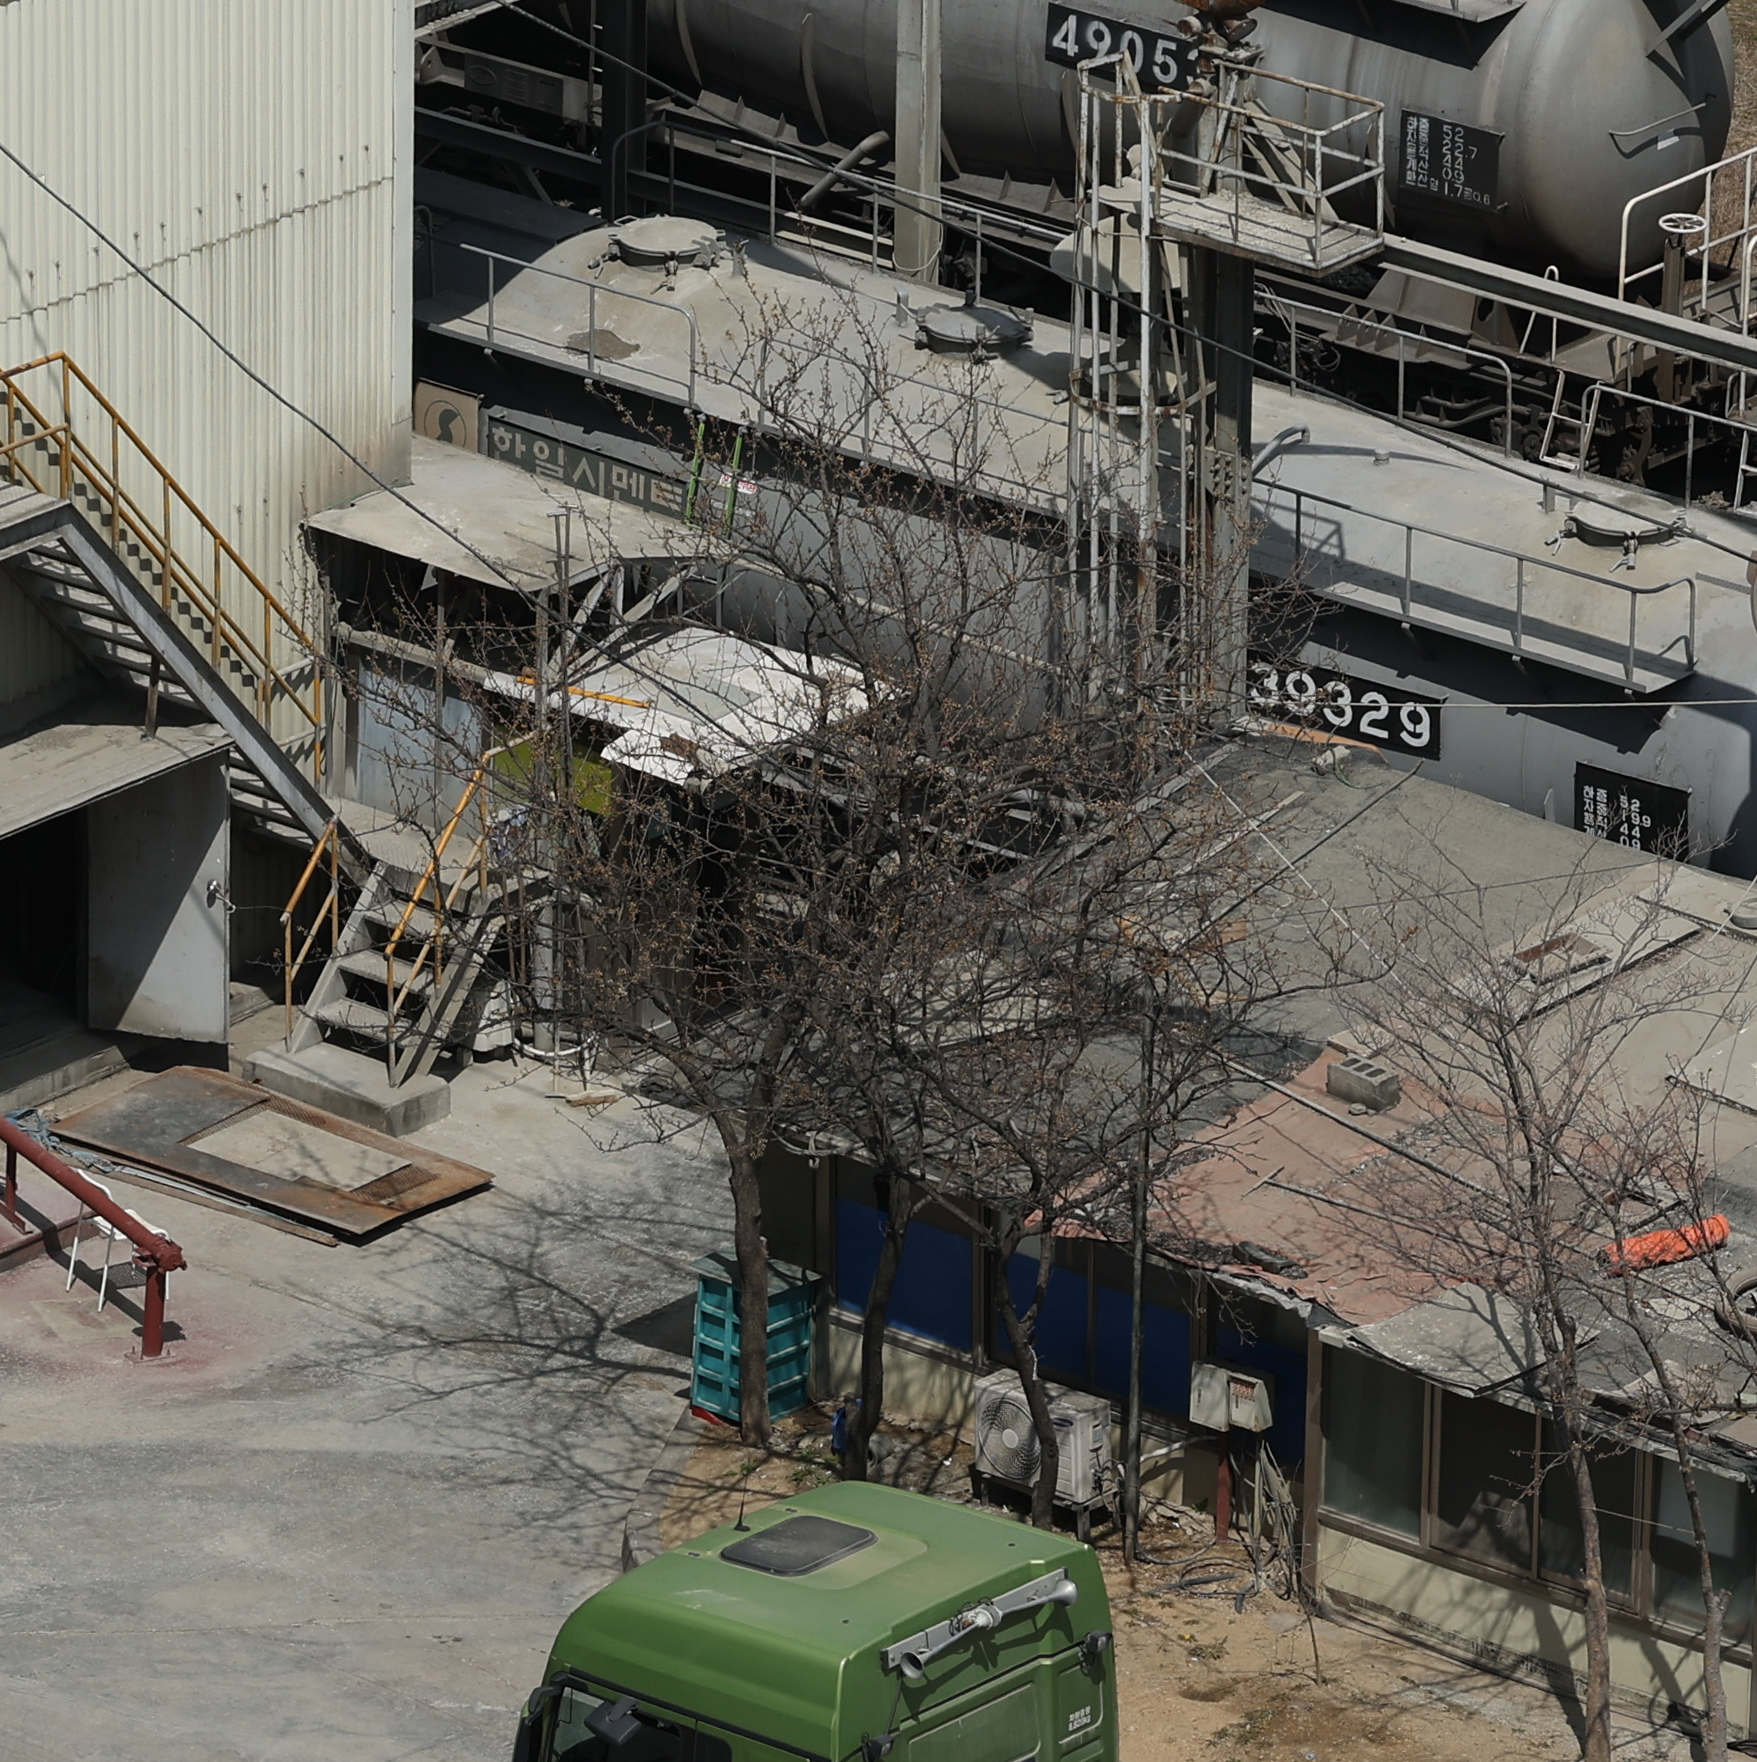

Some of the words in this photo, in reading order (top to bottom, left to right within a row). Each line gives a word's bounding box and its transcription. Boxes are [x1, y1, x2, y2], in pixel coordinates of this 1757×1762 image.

[1443, 124, 1464, 142] 52
[1442, 140, 1477, 159] 22.7
[1442, 154, 1463, 170] 44
[1620, 795, 1640, 812] 52
[1620, 823, 1640, 838] 44
